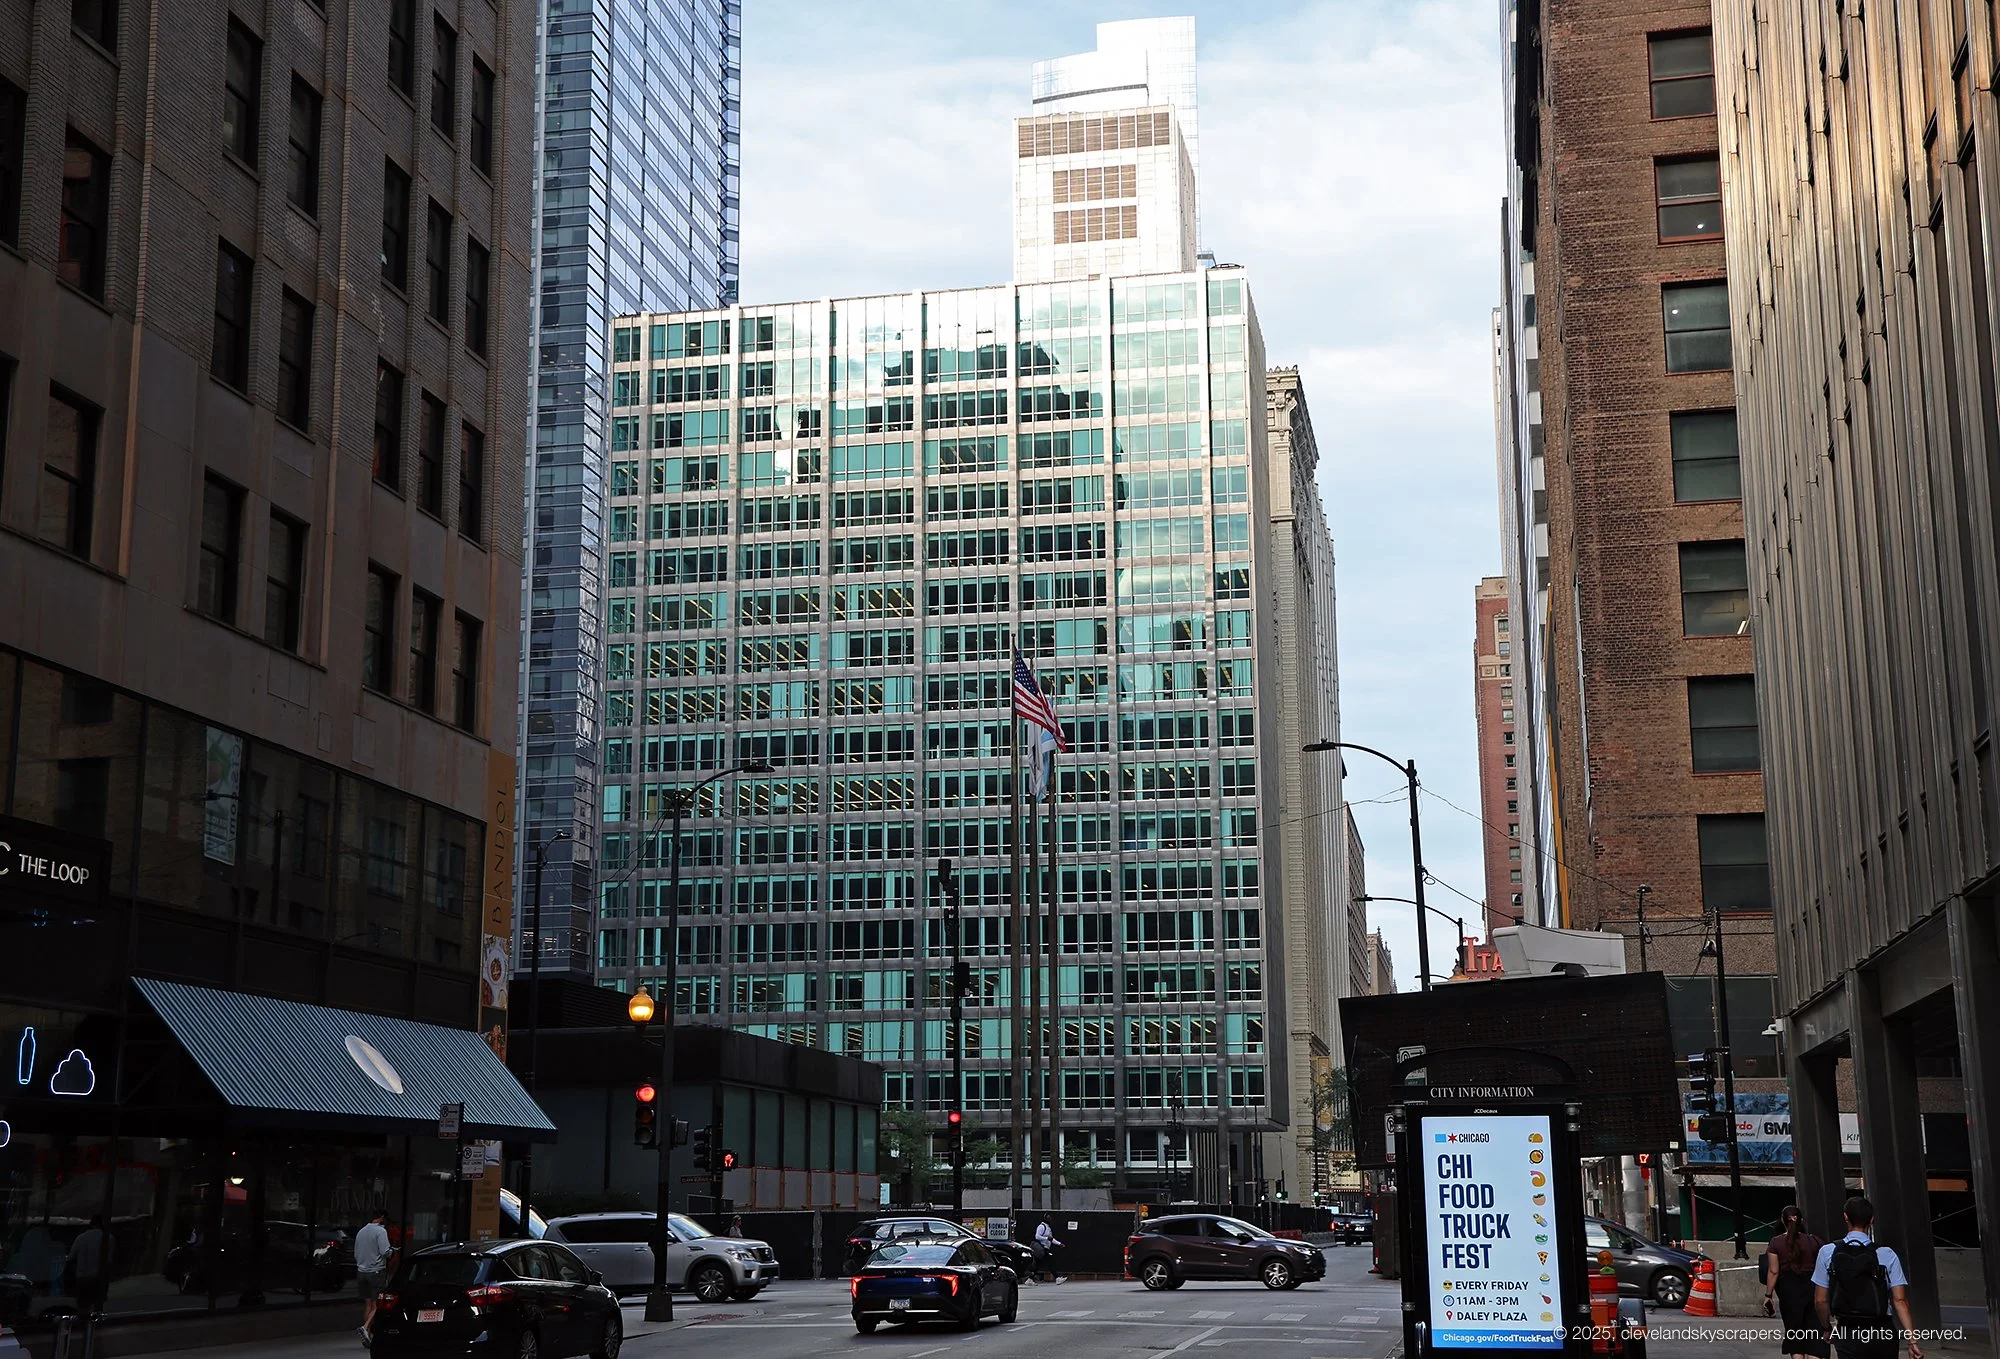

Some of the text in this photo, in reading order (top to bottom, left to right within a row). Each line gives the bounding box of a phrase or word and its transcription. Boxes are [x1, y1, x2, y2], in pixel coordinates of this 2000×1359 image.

[492, 781, 507, 924] BANDOL
[18, 853, 48, 877] THE
[50, 861, 90, 885] LOOP
[1430, 1086, 1535, 1099] CITY INFORMATION
[1458, 1133, 1490, 1143] CHICAGO
[1437, 1154, 1473, 1179] CHI
[1438, 1183, 1495, 1209] FOOD
[1439, 1213, 1511, 1239] TRUCK
[1441, 1243, 1492, 1269] FEST
[1455, 1281, 1529, 1290] EVERY FRIDAY
[1456, 1296, 1486, 1306] 11AM
[1496, 1296, 1519, 1306] 3PM
[1457, 1312, 1528, 1321] DALEY PLAZA
[1442, 1333, 1554, 1343] Chicago.gov/FoodTruckFest
